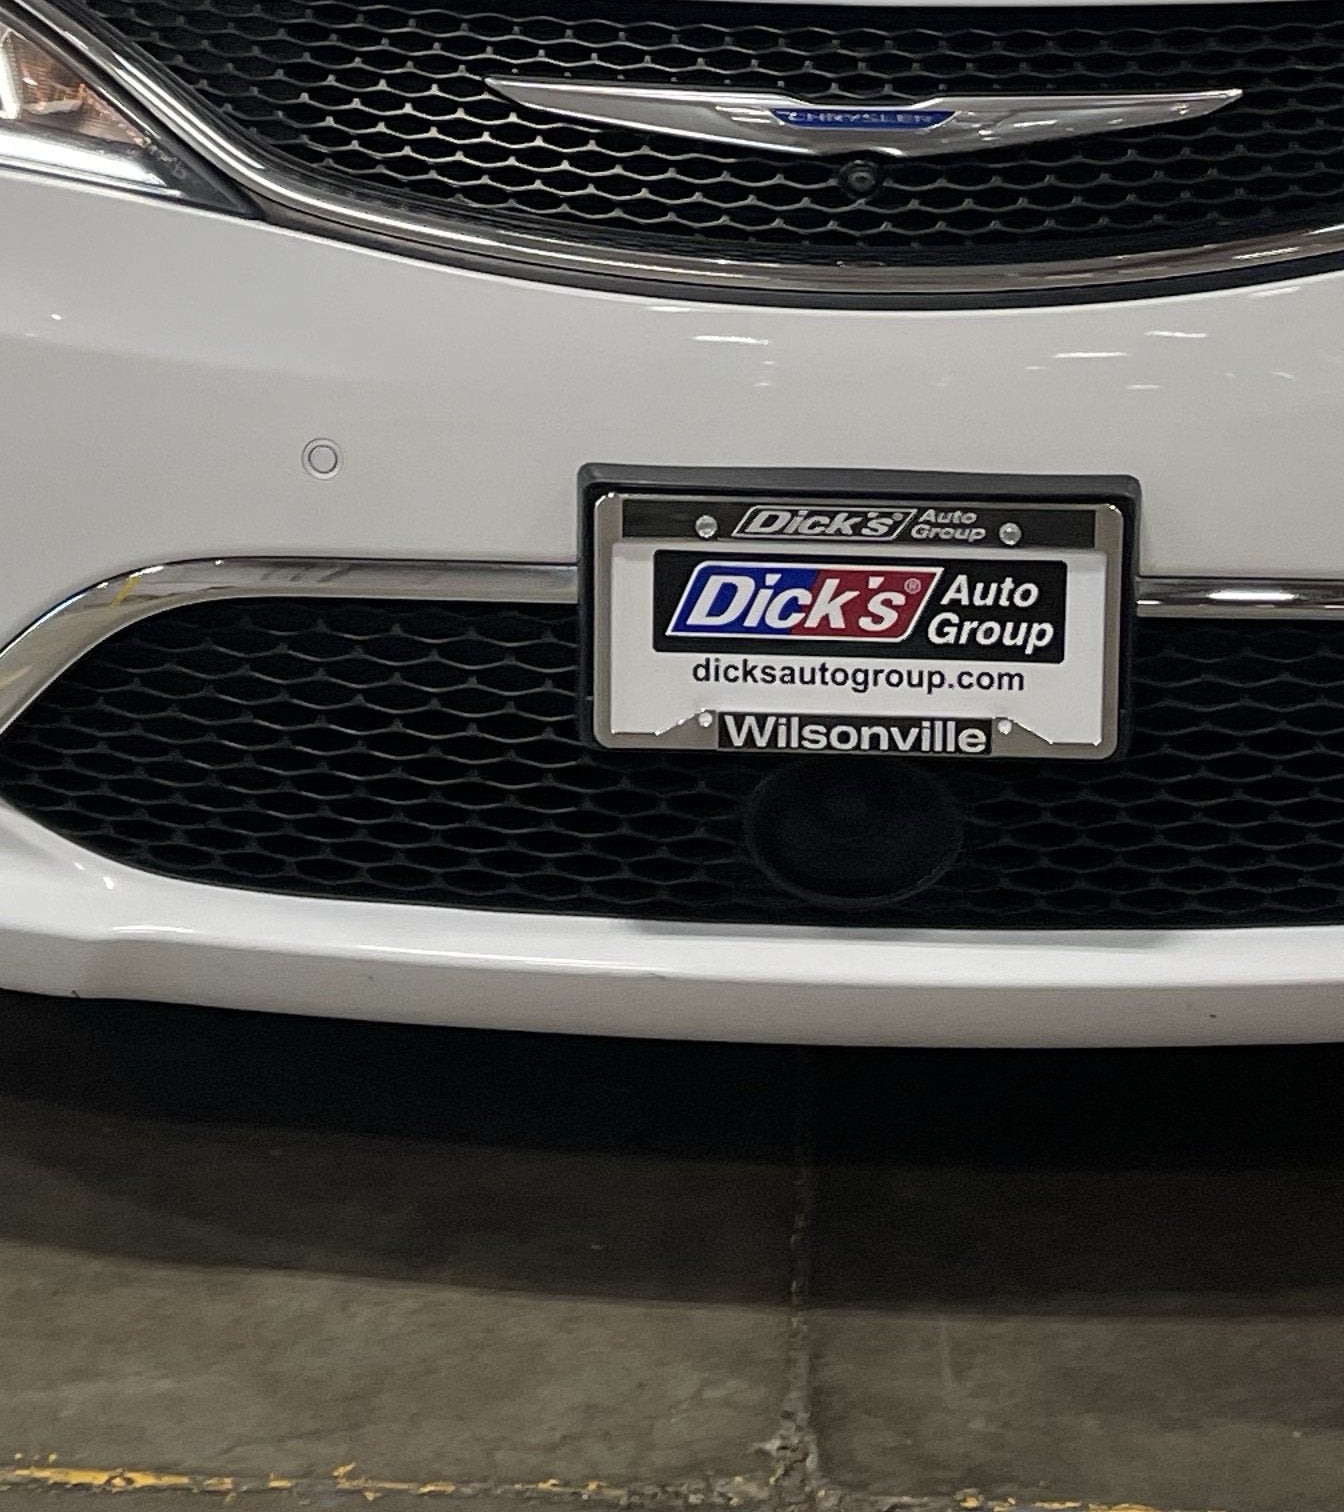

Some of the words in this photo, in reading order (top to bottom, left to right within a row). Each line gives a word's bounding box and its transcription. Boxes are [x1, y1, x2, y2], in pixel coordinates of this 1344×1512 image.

[787, 109, 932, 124] CHRYSLER
[911, 523, 987, 542] Group
[918, 509, 977, 524] Auto
[941, 574, 1039, 609] Auto
[927, 612, 1055, 654] Group
[692, 658, 1025, 693] dicksautogroup.com
[723, 714, 988, 754] Wilsonville
